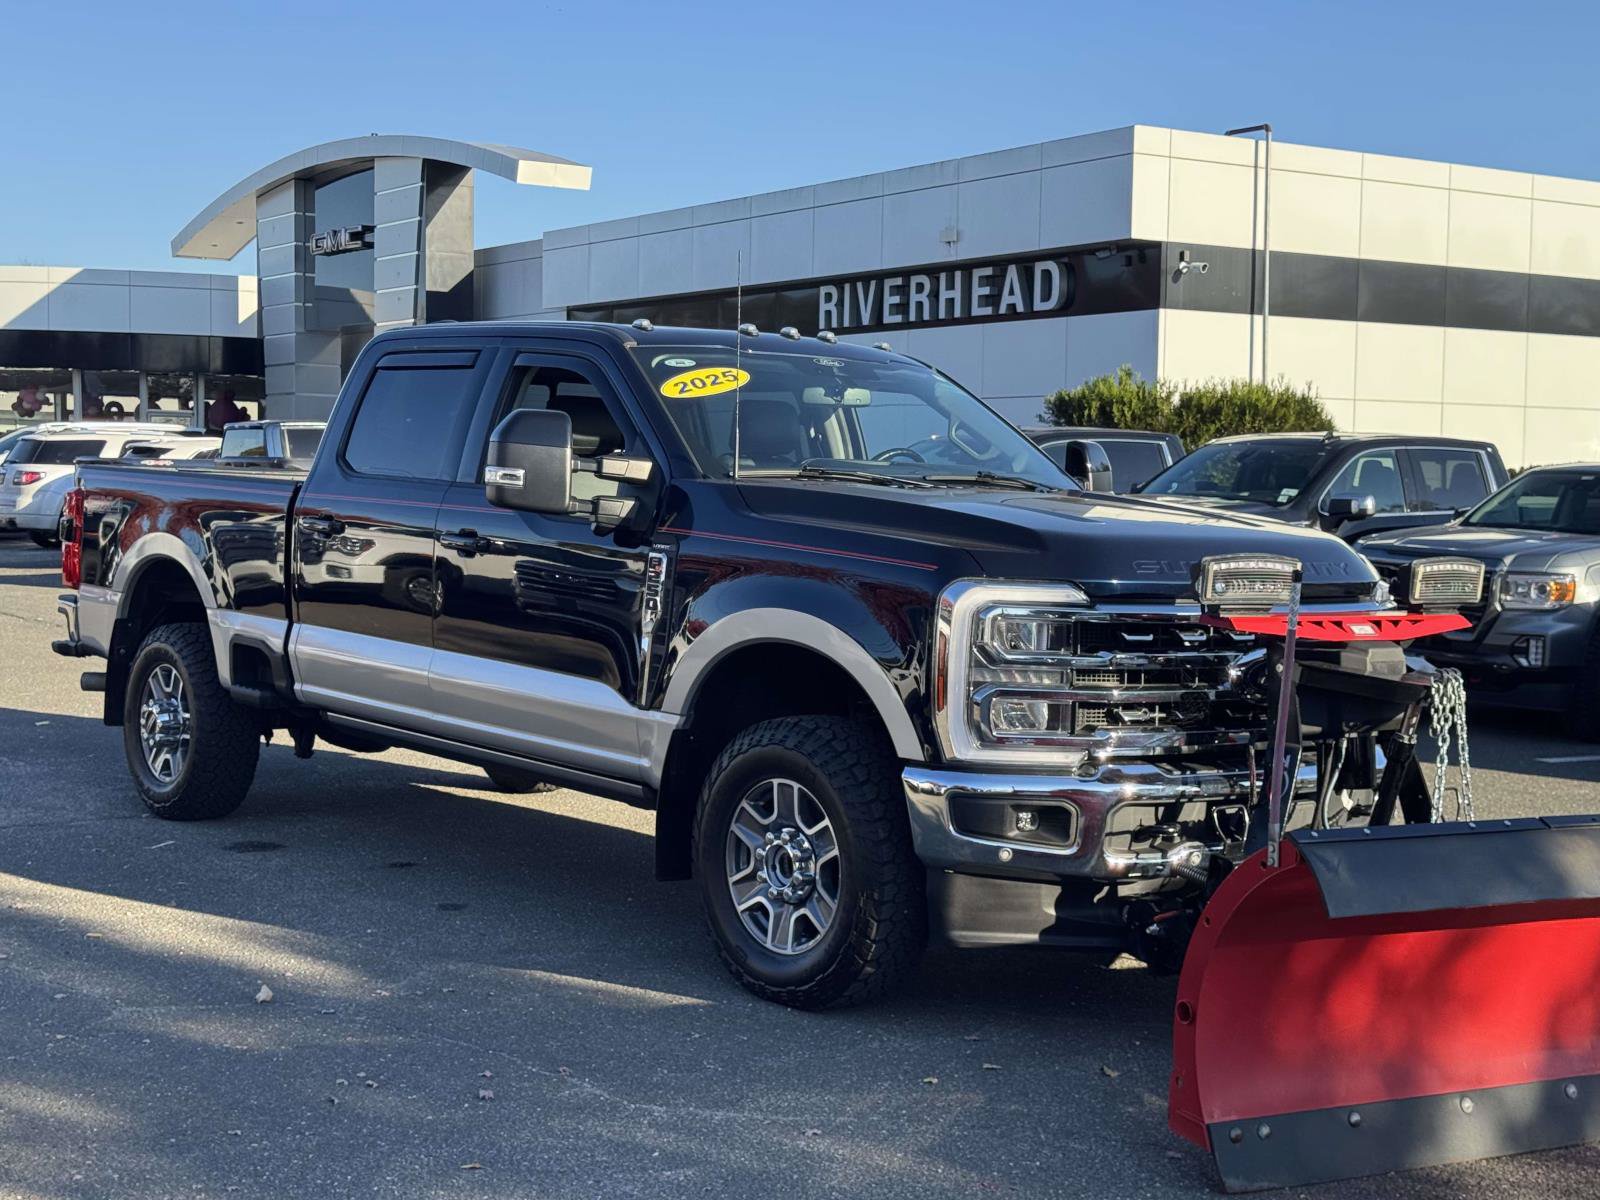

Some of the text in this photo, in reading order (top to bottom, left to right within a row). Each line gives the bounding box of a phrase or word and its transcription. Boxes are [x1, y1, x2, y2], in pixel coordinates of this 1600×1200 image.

[310, 225, 364, 256] GMC
[818, 260, 1061, 330] RIVERHEAD
[673, 370, 740, 395] 2025
